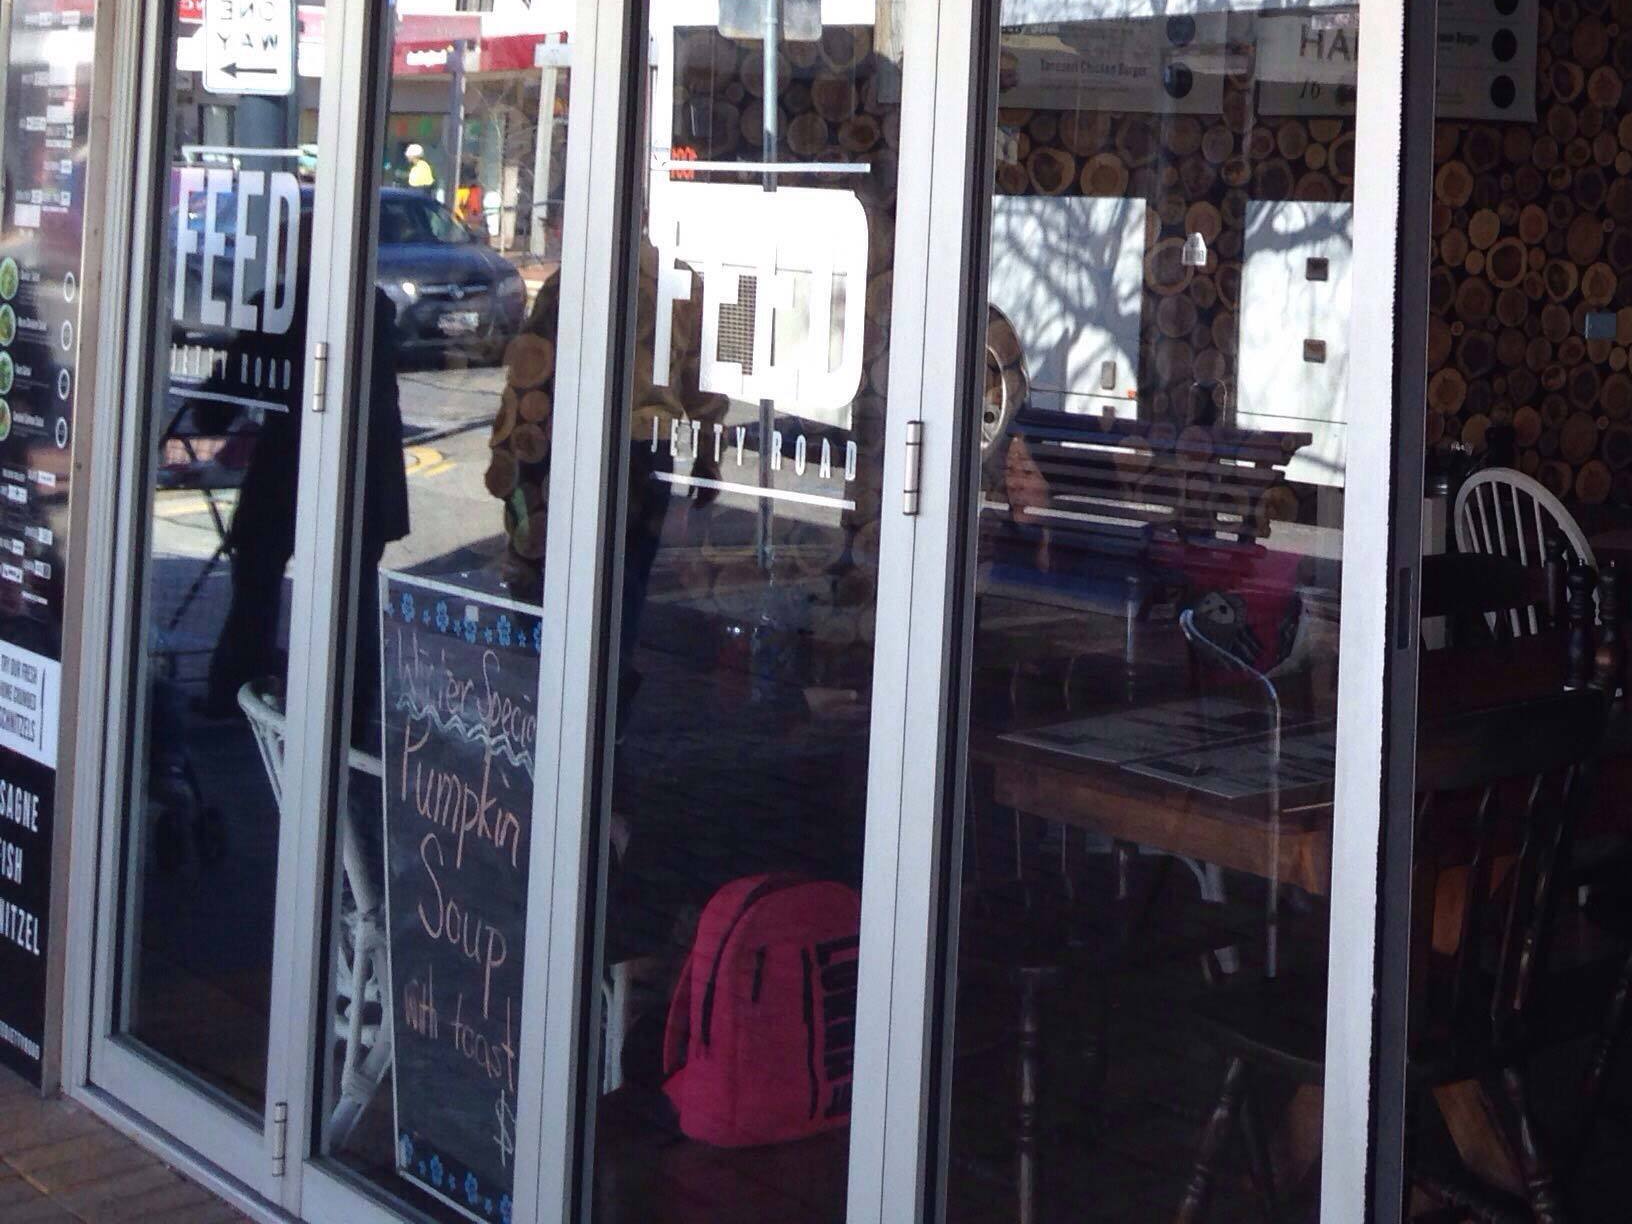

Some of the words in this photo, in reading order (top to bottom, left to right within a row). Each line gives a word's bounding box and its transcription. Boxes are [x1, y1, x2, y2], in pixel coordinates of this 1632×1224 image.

[1300, 25, 1359, 65] HA
[173, 168, 301, 336] FEED
[771, 430, 857, 482] ROAD
[401, 715, 521, 869] Pumpkin
[417, 832, 507, 1021] Soup
